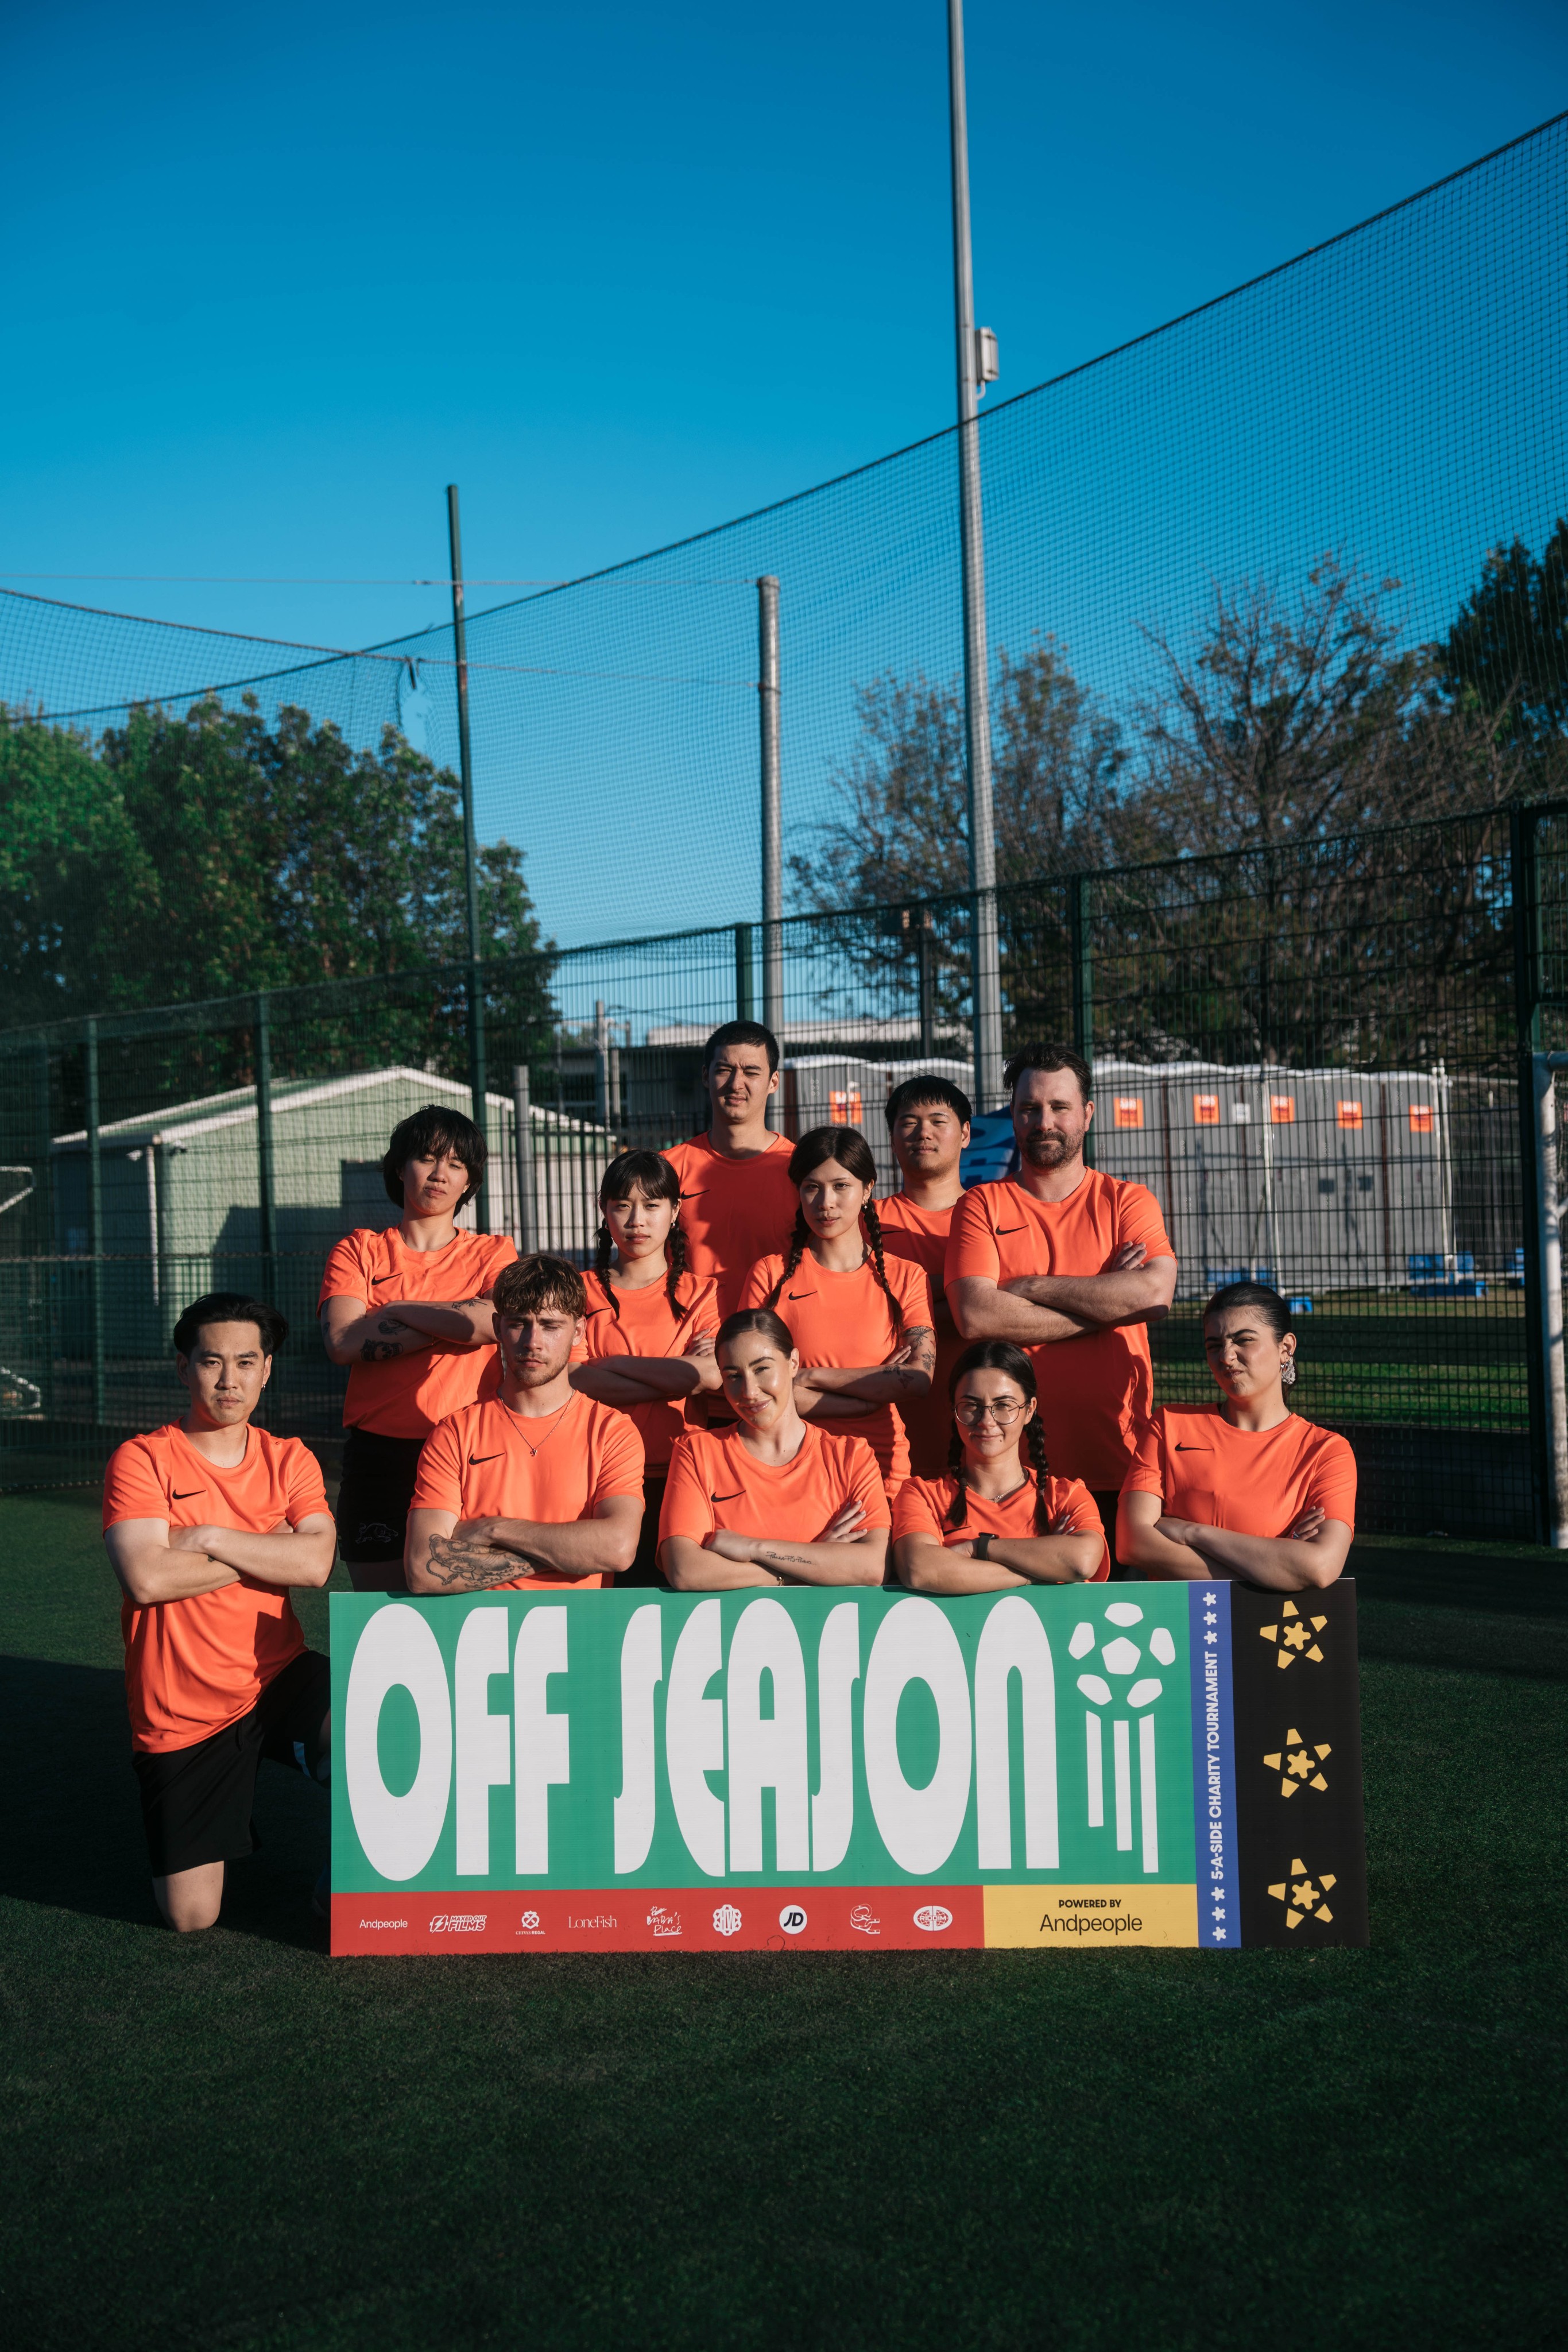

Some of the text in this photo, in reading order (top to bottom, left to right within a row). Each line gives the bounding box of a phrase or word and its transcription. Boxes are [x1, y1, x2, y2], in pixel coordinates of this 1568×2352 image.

[345, 1595, 1059, 1882] OFF SEASON
[1205, 1651, 1224, 1880] 5-A-SIDE CHARITY TOURNAMENT
[1059, 1899, 1121, 1908] POWERED BY
[359, 1918, 408, 1930] Andpeople
[448, 1921, 486, 1932] FILMS
[568, 1915, 617, 1928] LoneFish
[783, 1912, 804, 1927] JD
[1040, 1913, 1143, 1936] Andpeople
